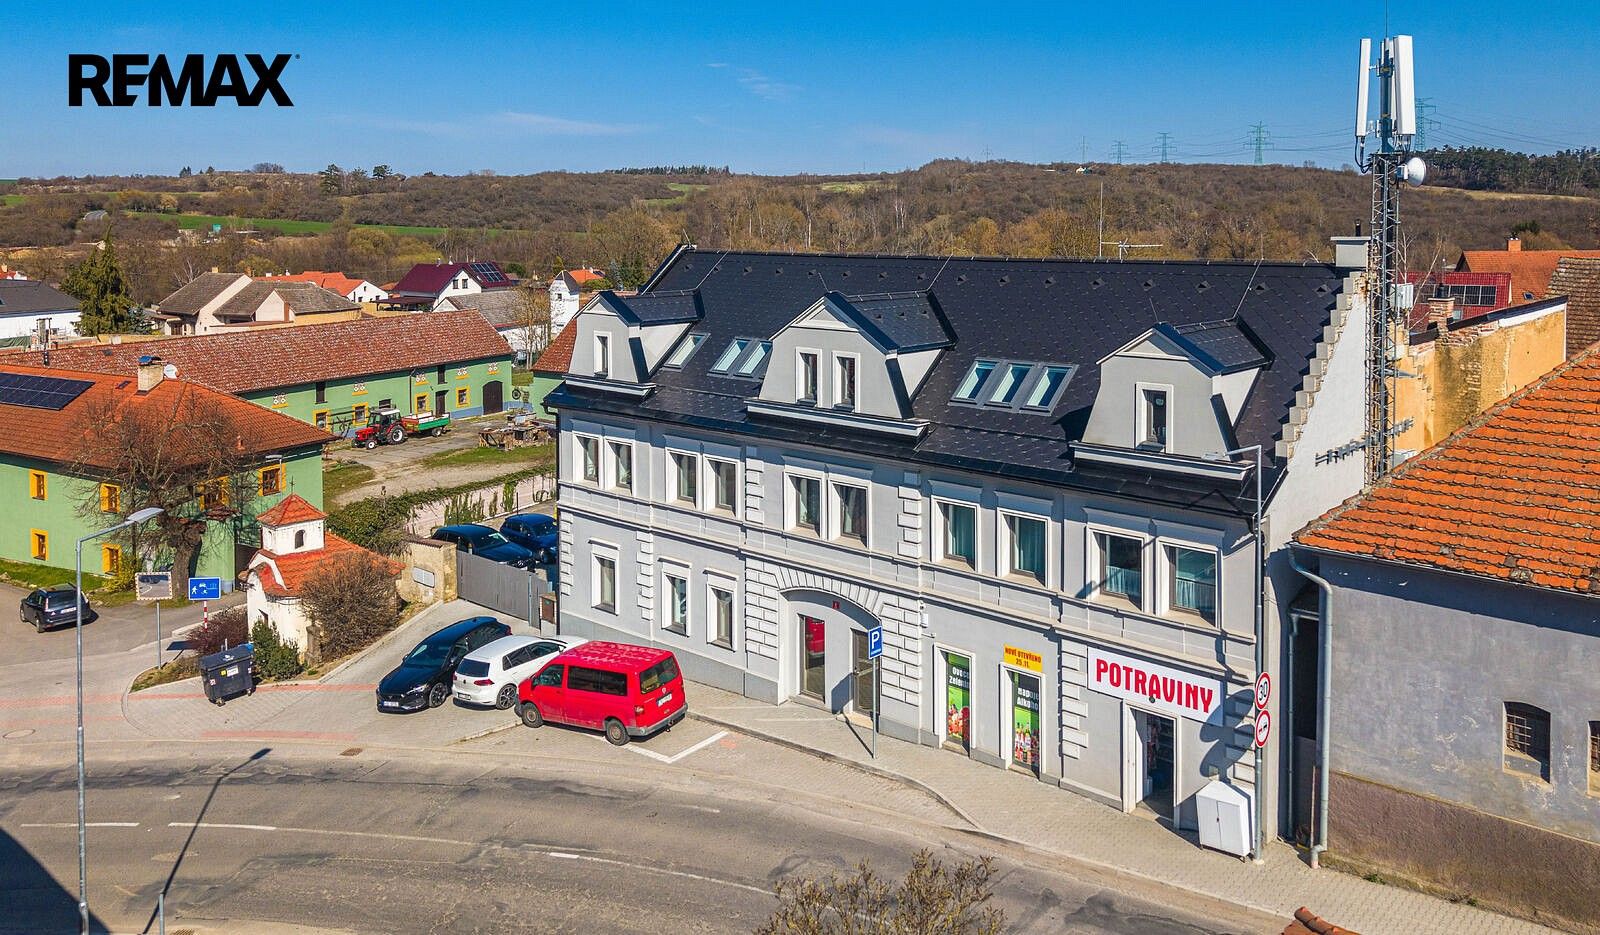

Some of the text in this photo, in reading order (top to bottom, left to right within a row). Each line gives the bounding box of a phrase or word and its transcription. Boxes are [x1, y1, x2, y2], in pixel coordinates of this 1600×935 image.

[871, 631, 880, 650] P
[1096, 658, 1213, 714] POTRAVINY
[1259, 681, 1269, 702] 30
